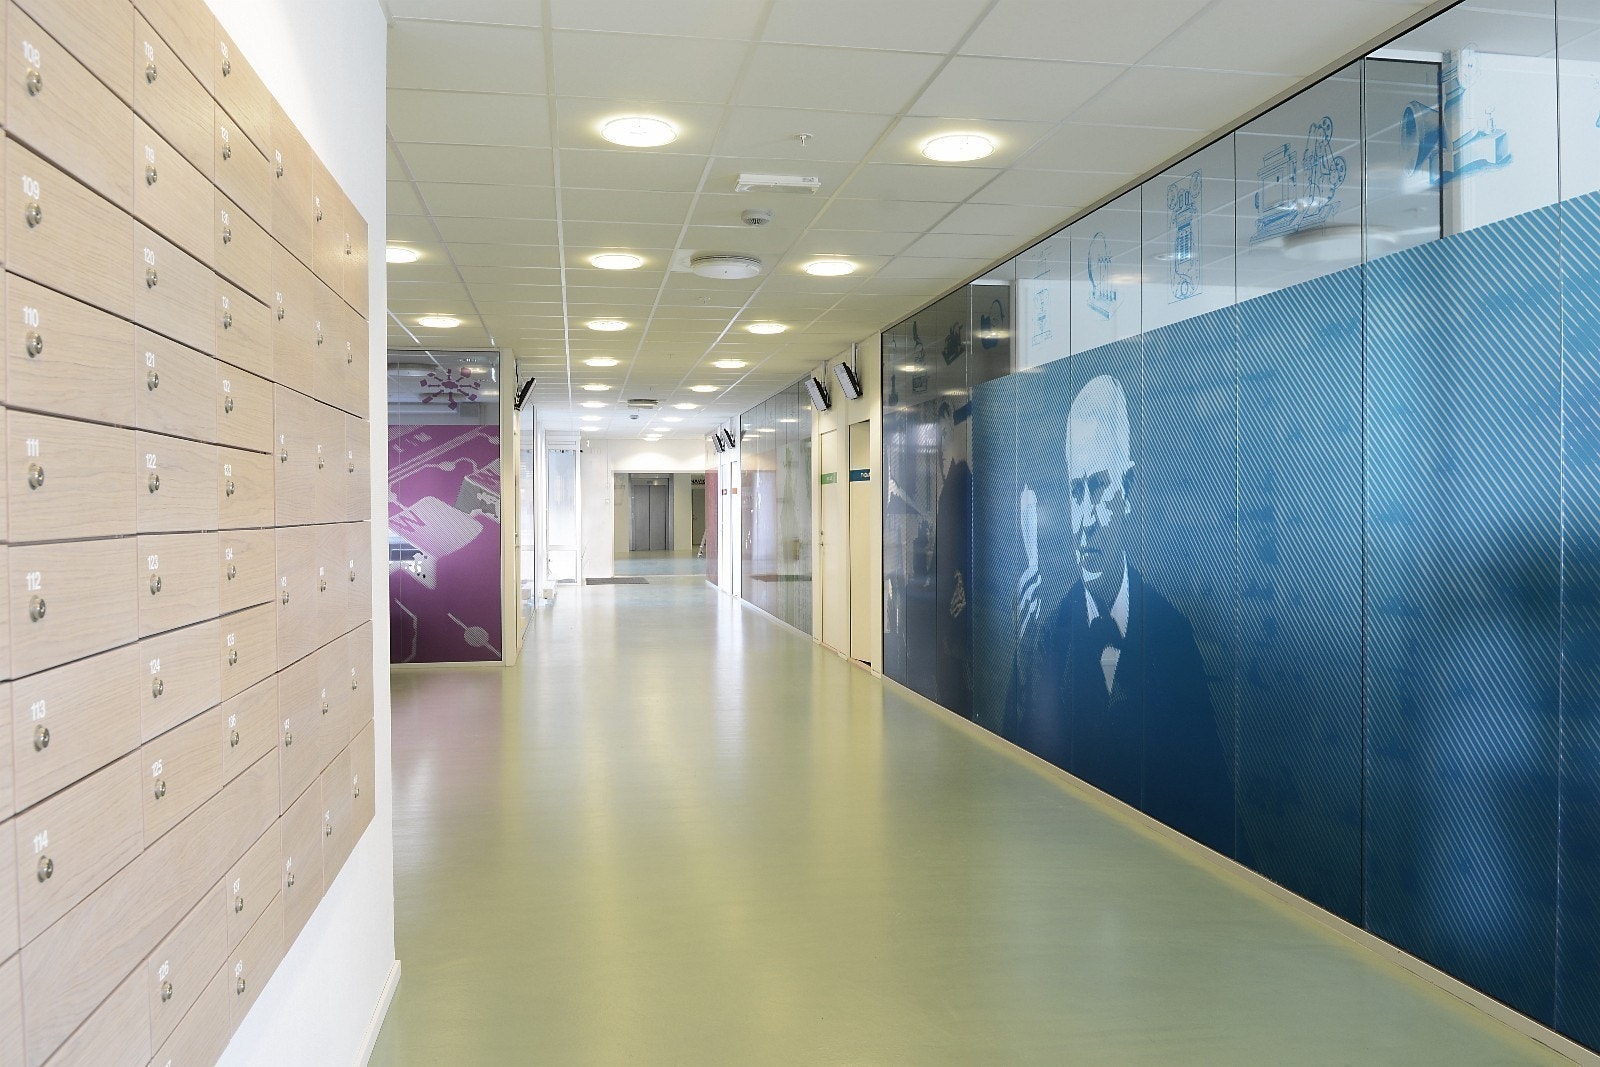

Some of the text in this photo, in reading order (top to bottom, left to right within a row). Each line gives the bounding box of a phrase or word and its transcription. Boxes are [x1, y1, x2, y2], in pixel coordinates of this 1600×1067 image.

[22, 41, 40, 68] 108
[144, 41, 154, 61] 118
[22, 175, 40, 200] 109
[144, 247, 154, 265] 120
[23, 306, 39, 327] 110
[145, 351, 155, 368] 121
[26, 438, 40, 457] 111
[145, 453, 156, 469] 122
[147, 554, 159, 570] 123
[25, 571, 41, 591] 112
[149, 657, 160, 674] 124
[31, 700, 46, 721] 113
[152, 758, 163, 778] 125
[33, 830, 48, 853] 114
[158, 960, 168, 982] 126
